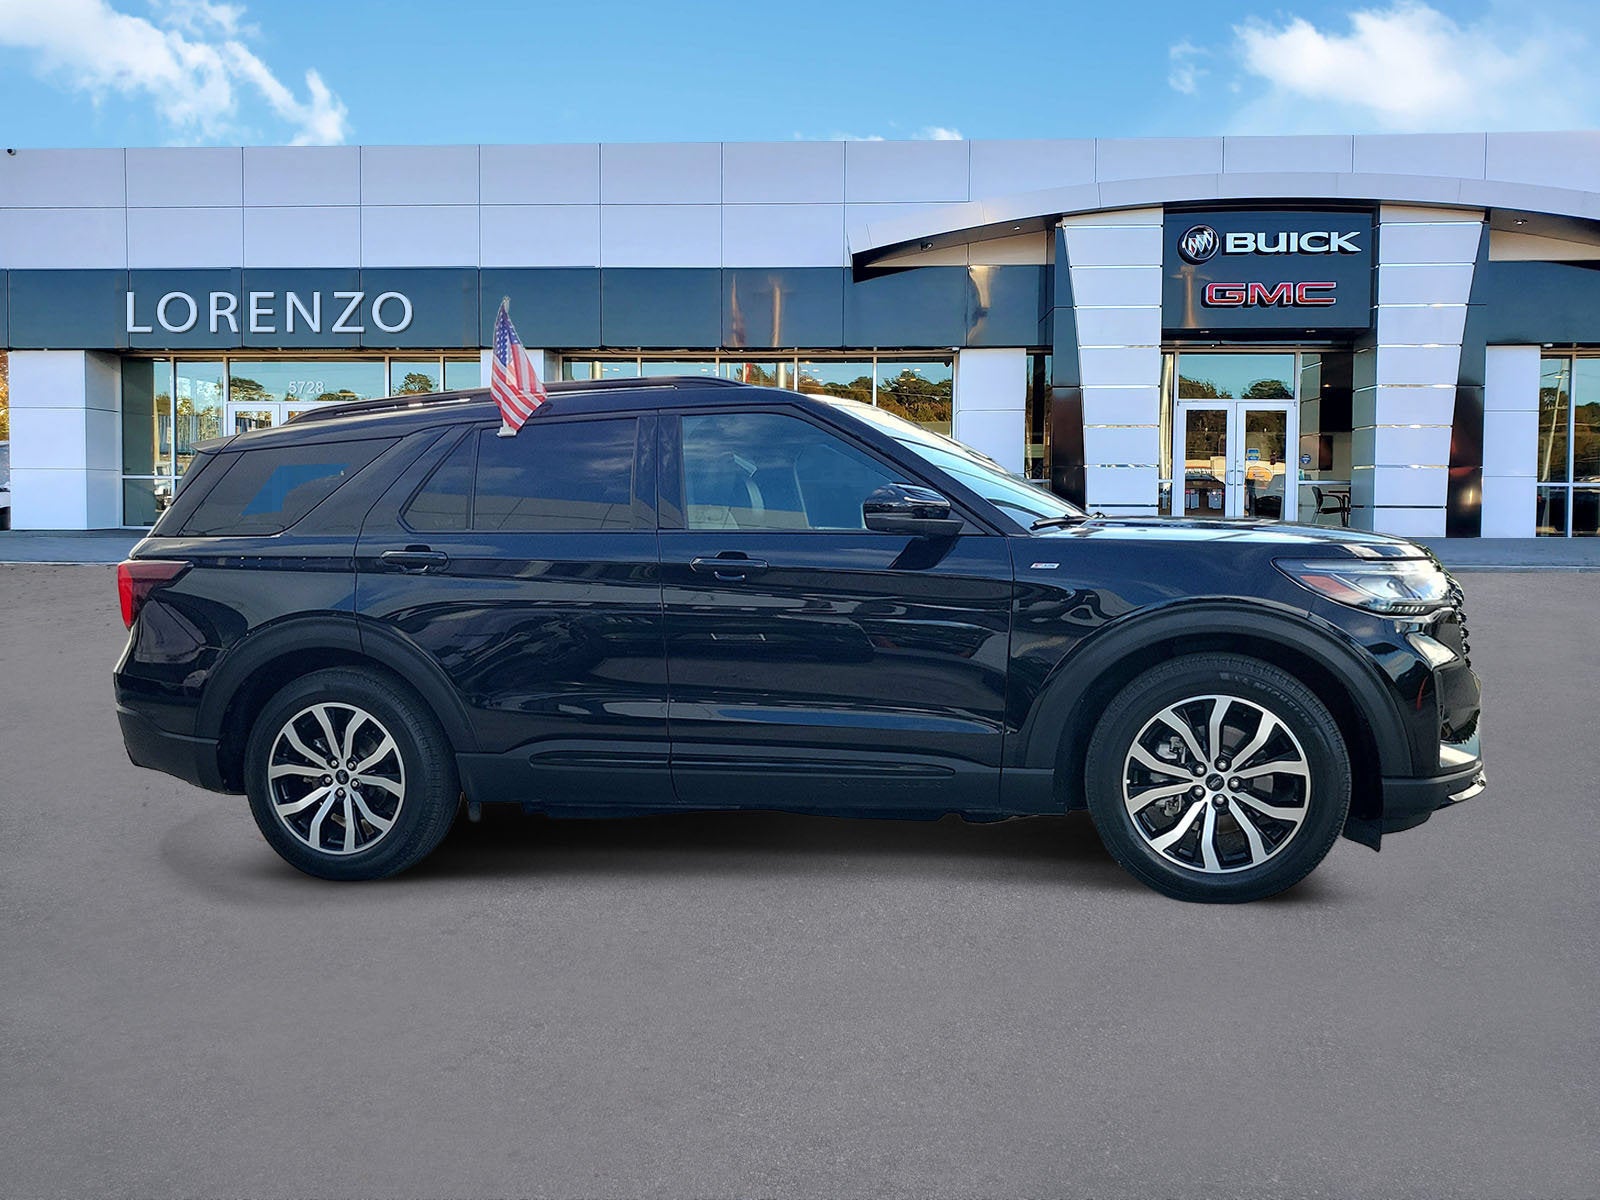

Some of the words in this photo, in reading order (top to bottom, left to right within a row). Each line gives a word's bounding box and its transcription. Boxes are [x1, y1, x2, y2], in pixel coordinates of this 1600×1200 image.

[1226, 231, 1362, 253] BUICK
[1205, 281, 1337, 305] GMC
[126, 291, 413, 333] LORENZO
[288, 380, 325, 394] 5728
